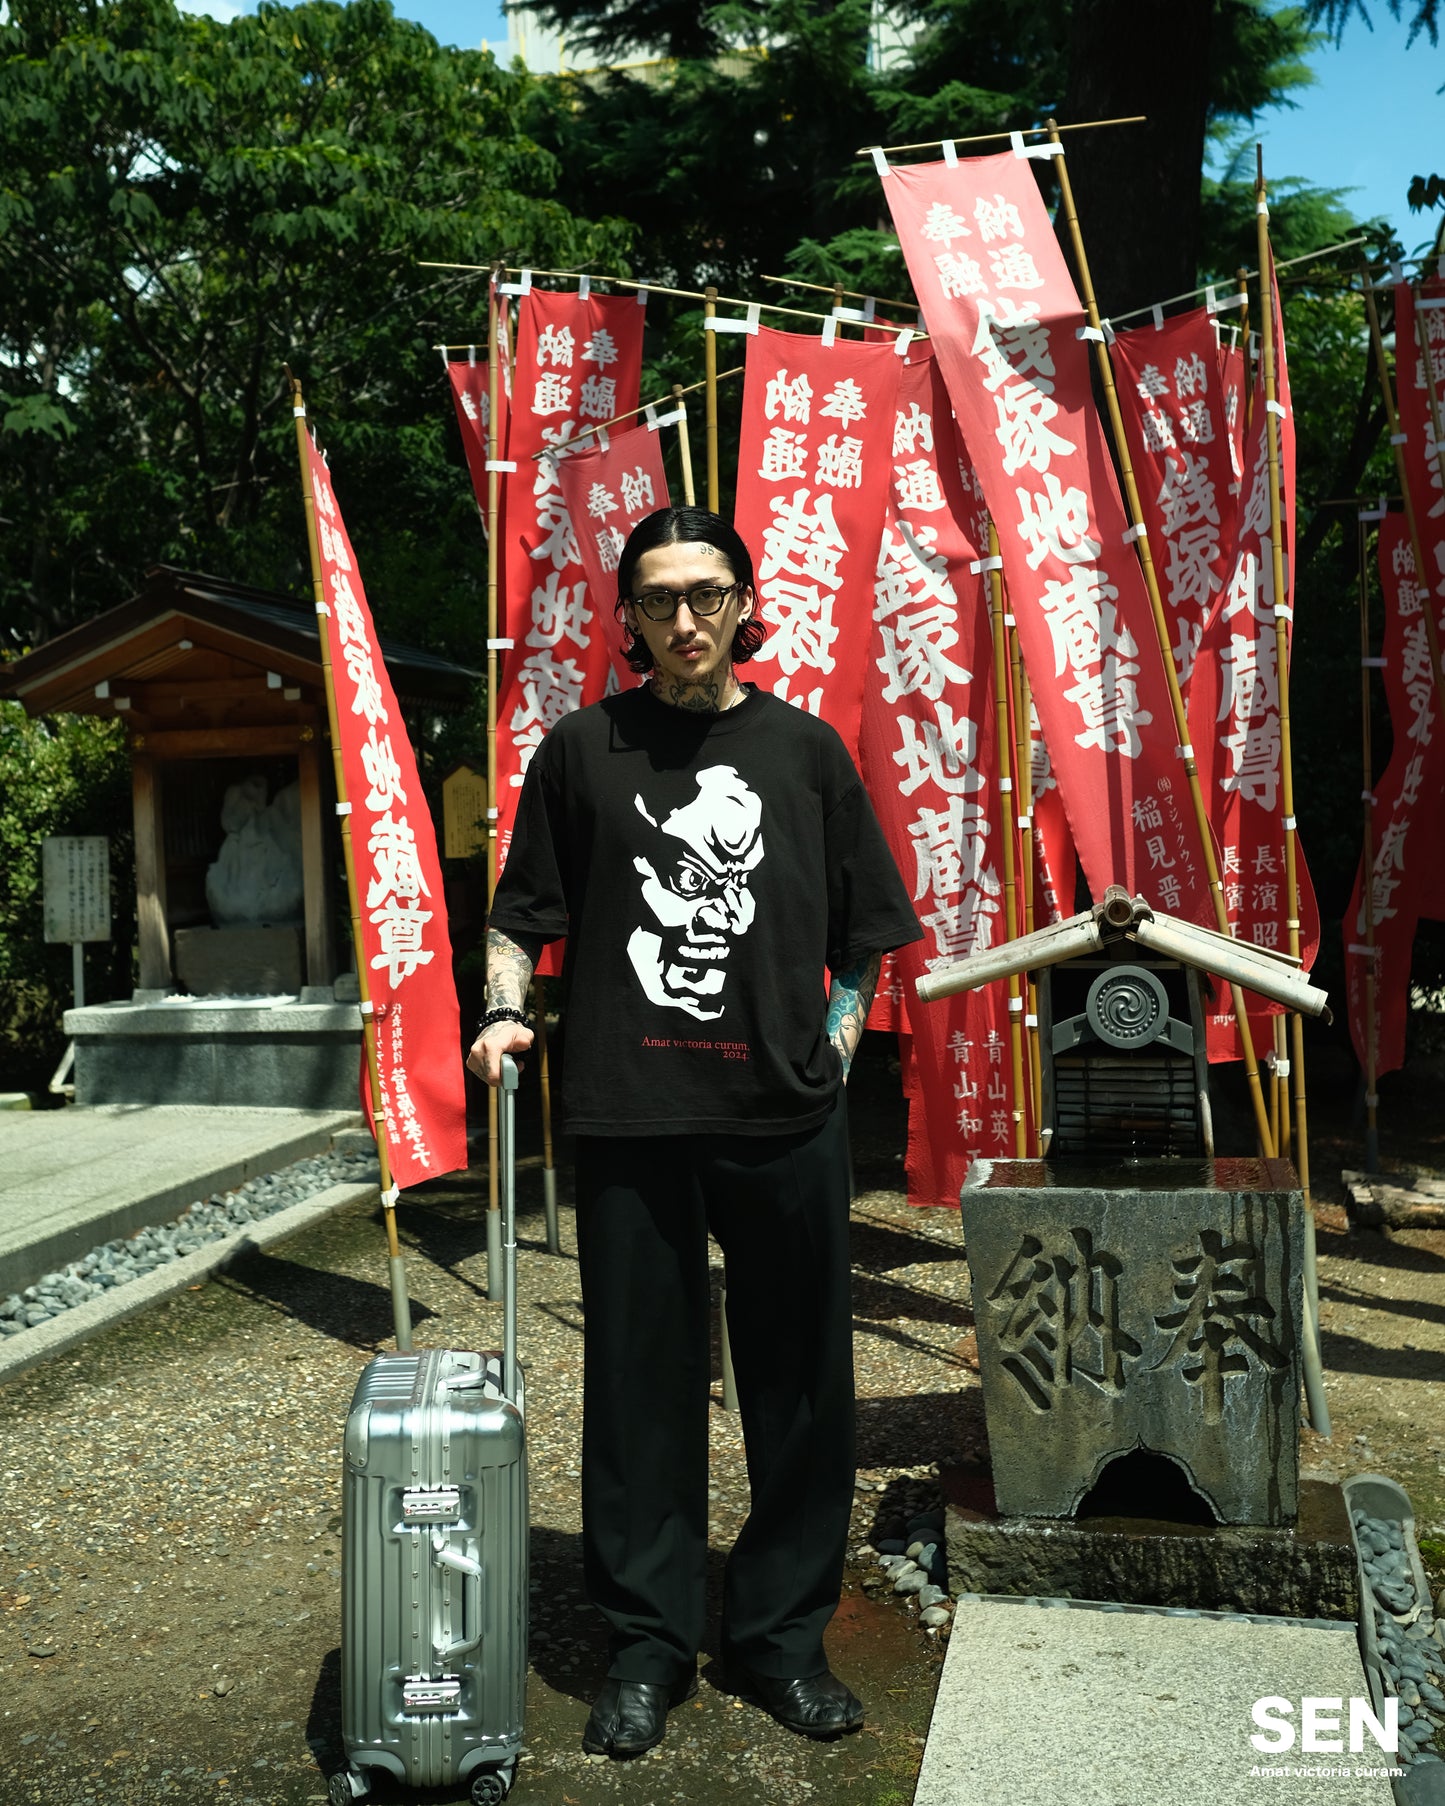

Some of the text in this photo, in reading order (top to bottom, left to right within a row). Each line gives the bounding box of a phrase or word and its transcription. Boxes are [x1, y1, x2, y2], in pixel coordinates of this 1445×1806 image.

[921, 194, 1025, 248] 奉納
[935, 242, 1045, 300] 融通
[970, 298, 1152, 759] 銭塚地蔵尊
[641, 1035, 671, 1047] Amat
[673, 1039, 712, 1049] victoria
